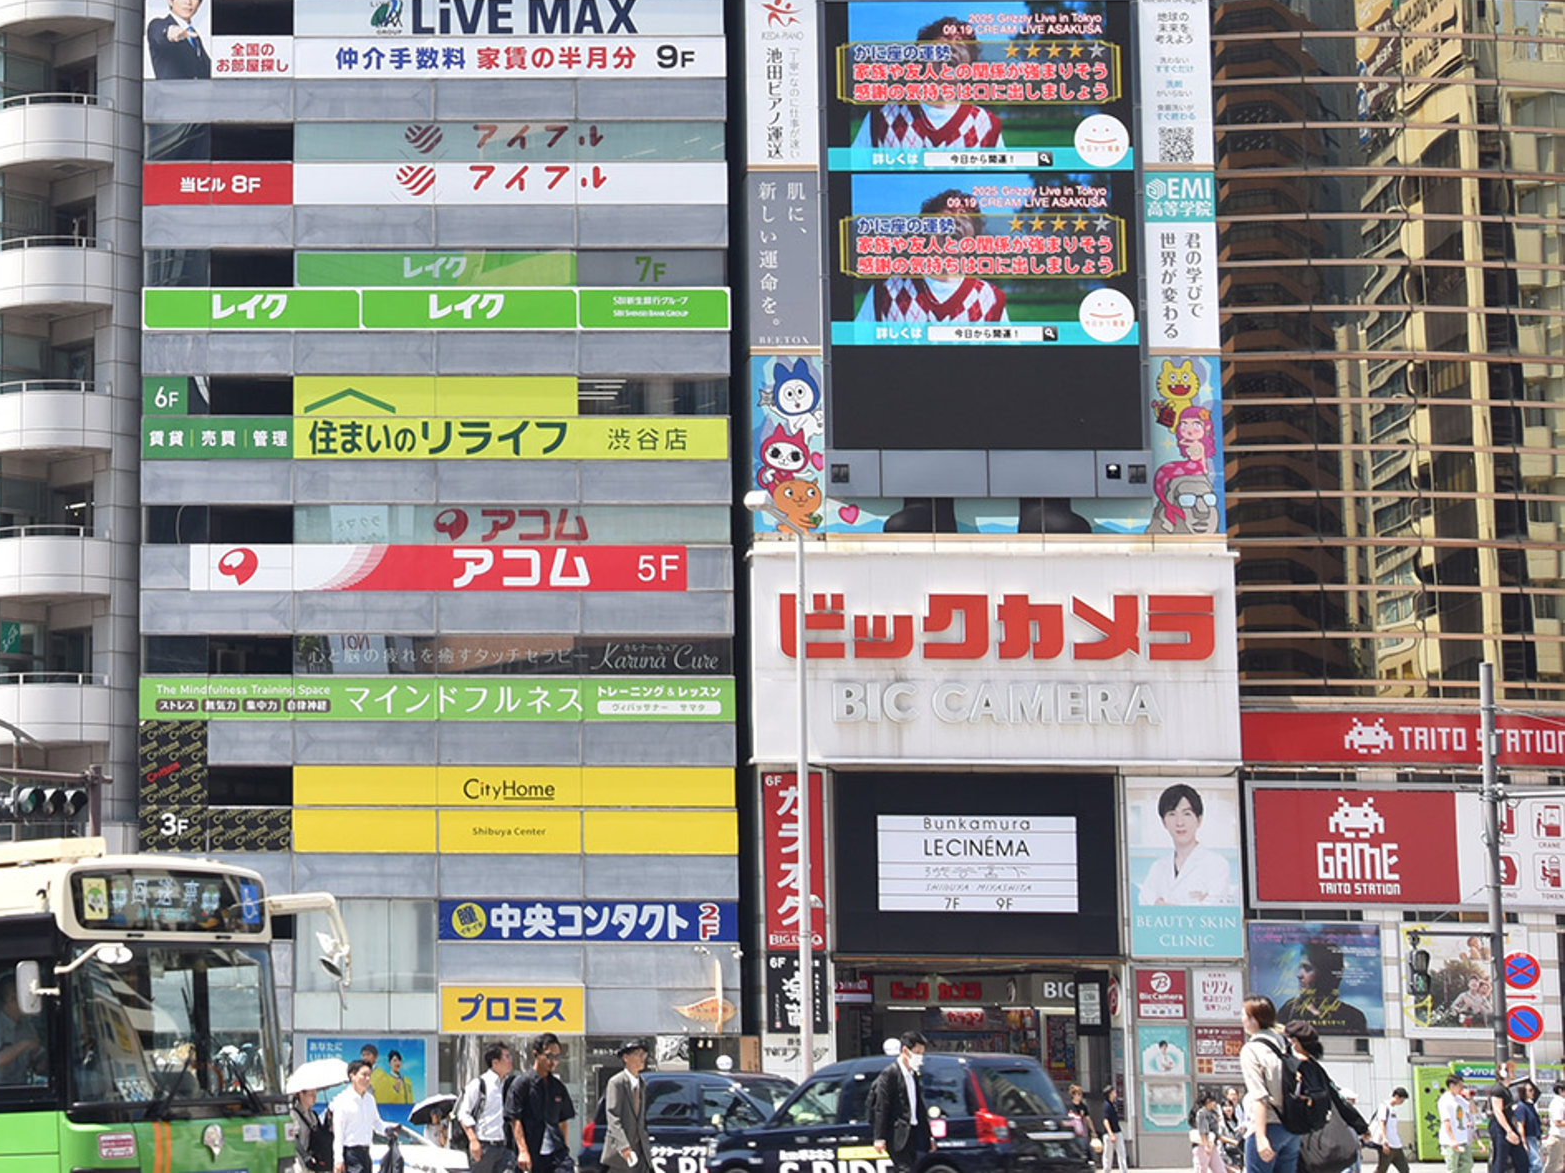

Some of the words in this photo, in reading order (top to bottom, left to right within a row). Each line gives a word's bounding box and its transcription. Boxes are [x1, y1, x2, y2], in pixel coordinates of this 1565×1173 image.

[997, 13, 1033, 25] Grizzly
[1036, 13, 1059, 24] Live
[1061, 13, 1071, 24] in
[1073, 13, 1103, 25] Tokyo
[1157, 11, 1189, 22] 地球の
[975, 24, 1018, 34] CREAM
[1020, 24, 1046, 34] LIVE
[1047, 24, 1104, 34] ASAKUSA
[1158, 23, 1189, 33] 未来を
[1155, 34, 1193, 45] 考えよう
[231, 42, 275, 57] 全国の
[335, 46, 466, 70] 仲介手数料
[476, 45, 637, 71] 家賃の半月分
[656, 44, 696, 69] 9F
[854, 44, 951, 61] かに座の運勢
[216, 57, 289, 73] お部屋探し
[853, 62, 1109, 80] 家族や友人との関係が強まりそう
[853, 83, 1109, 101] 感謝の気持ちは口に出しましょう
[766, 47, 784, 160] 池田ピアノ運送
[473, 124, 605, 149] アイフル
[872, 152, 918, 165] 詳しくは
[180, 176, 226, 193] 当ビル
[231, 175, 262, 194] 8F
[468, 164, 607, 191] アイフル
[1001, 186, 1038, 198] Grizzly
[1040, 186, 1063, 197] Live
[1065, 186, 1074, 197] in
[1076, 186, 1107, 198] Tokyo
[1167, 178, 1212, 199] EMI
[979, 197, 1023, 207] CREAM
[1024, 197, 1050, 207] LIVE
[1051, 197, 1108, 207] ASAKUSA
[1147, 200, 1213, 217] 高等学院
[858, 217, 956, 234] かに座の運勢
[758, 181, 780, 326] 新しい運命を。
[856, 236, 1113, 254] 家族や友人との関係が強まりそう
[403, 256, 467, 279] レイク
[635, 256, 667, 283] 7F
[856, 255, 1113, 274] 感謝の気持ちは口に出しましょう
[1185, 232, 1204, 319] 君の学びで
[1160, 232, 1179, 340] 世界が変わる
[211, 292, 288, 320] レイク
[428, 292, 505, 320] レイク
[876, 327, 922, 339] 詳しくは
[155, 387, 179, 408] 6F
[149, 429, 185, 448] 賃貸
[201, 429, 237, 448] 売買
[253, 429, 288, 448] 管理
[308, 420, 569, 456] 住まいのリライフ
[607, 428, 688, 452] 渋谷店
[481, 508, 590, 542] アコム
[452, 548, 591, 588] アコム
[637, 554, 681, 583] 5F
[778, 591, 1216, 662] ビックカメラ
[673, 643, 720, 671] Cure
[156, 685, 178, 695] The
[180, 684, 248, 695] Mindfulness
[251, 684, 295, 697] Training
[298, 685, 331, 697] Space
[344, 684, 584, 714] マインドフルネス
[597, 685, 664, 698] トレーニング
[678, 686, 722, 698] レッスン
[159, 700, 195, 712] ストレス
[246, 699, 278, 712] 集中力
[832, 681, 920, 725] BIC
[931, 682, 1164, 726] CAMERA
[1399, 727, 1467, 751] TAITO
[765, 775, 782, 787] 6F
[160, 812, 190, 837] 3F
[471, 825, 509, 839] Shibuya
[511, 825, 547, 837] Center
[923, 817, 1031, 831] Bunkamura
[1538, 841, 1561, 849] CRANE
[1316, 842, 1400, 881] GAME
[1319, 882, 1352, 895] TAITO
[1354, 882, 1402, 896] STATION
[944, 897, 960, 910] 7F
[996, 897, 1014, 910] 9F
[490, 902, 689, 940] 中央コンタクト
[1136, 915, 1198, 929] BEAUTY
[1200, 916, 1237, 929] SKIN
[1159, 934, 1216, 948] CLINIC
[770, 957, 786, 969] 6F
[1138, 991, 1184, 1002] BicCamera
[457, 993, 566, 1022] プロミス
